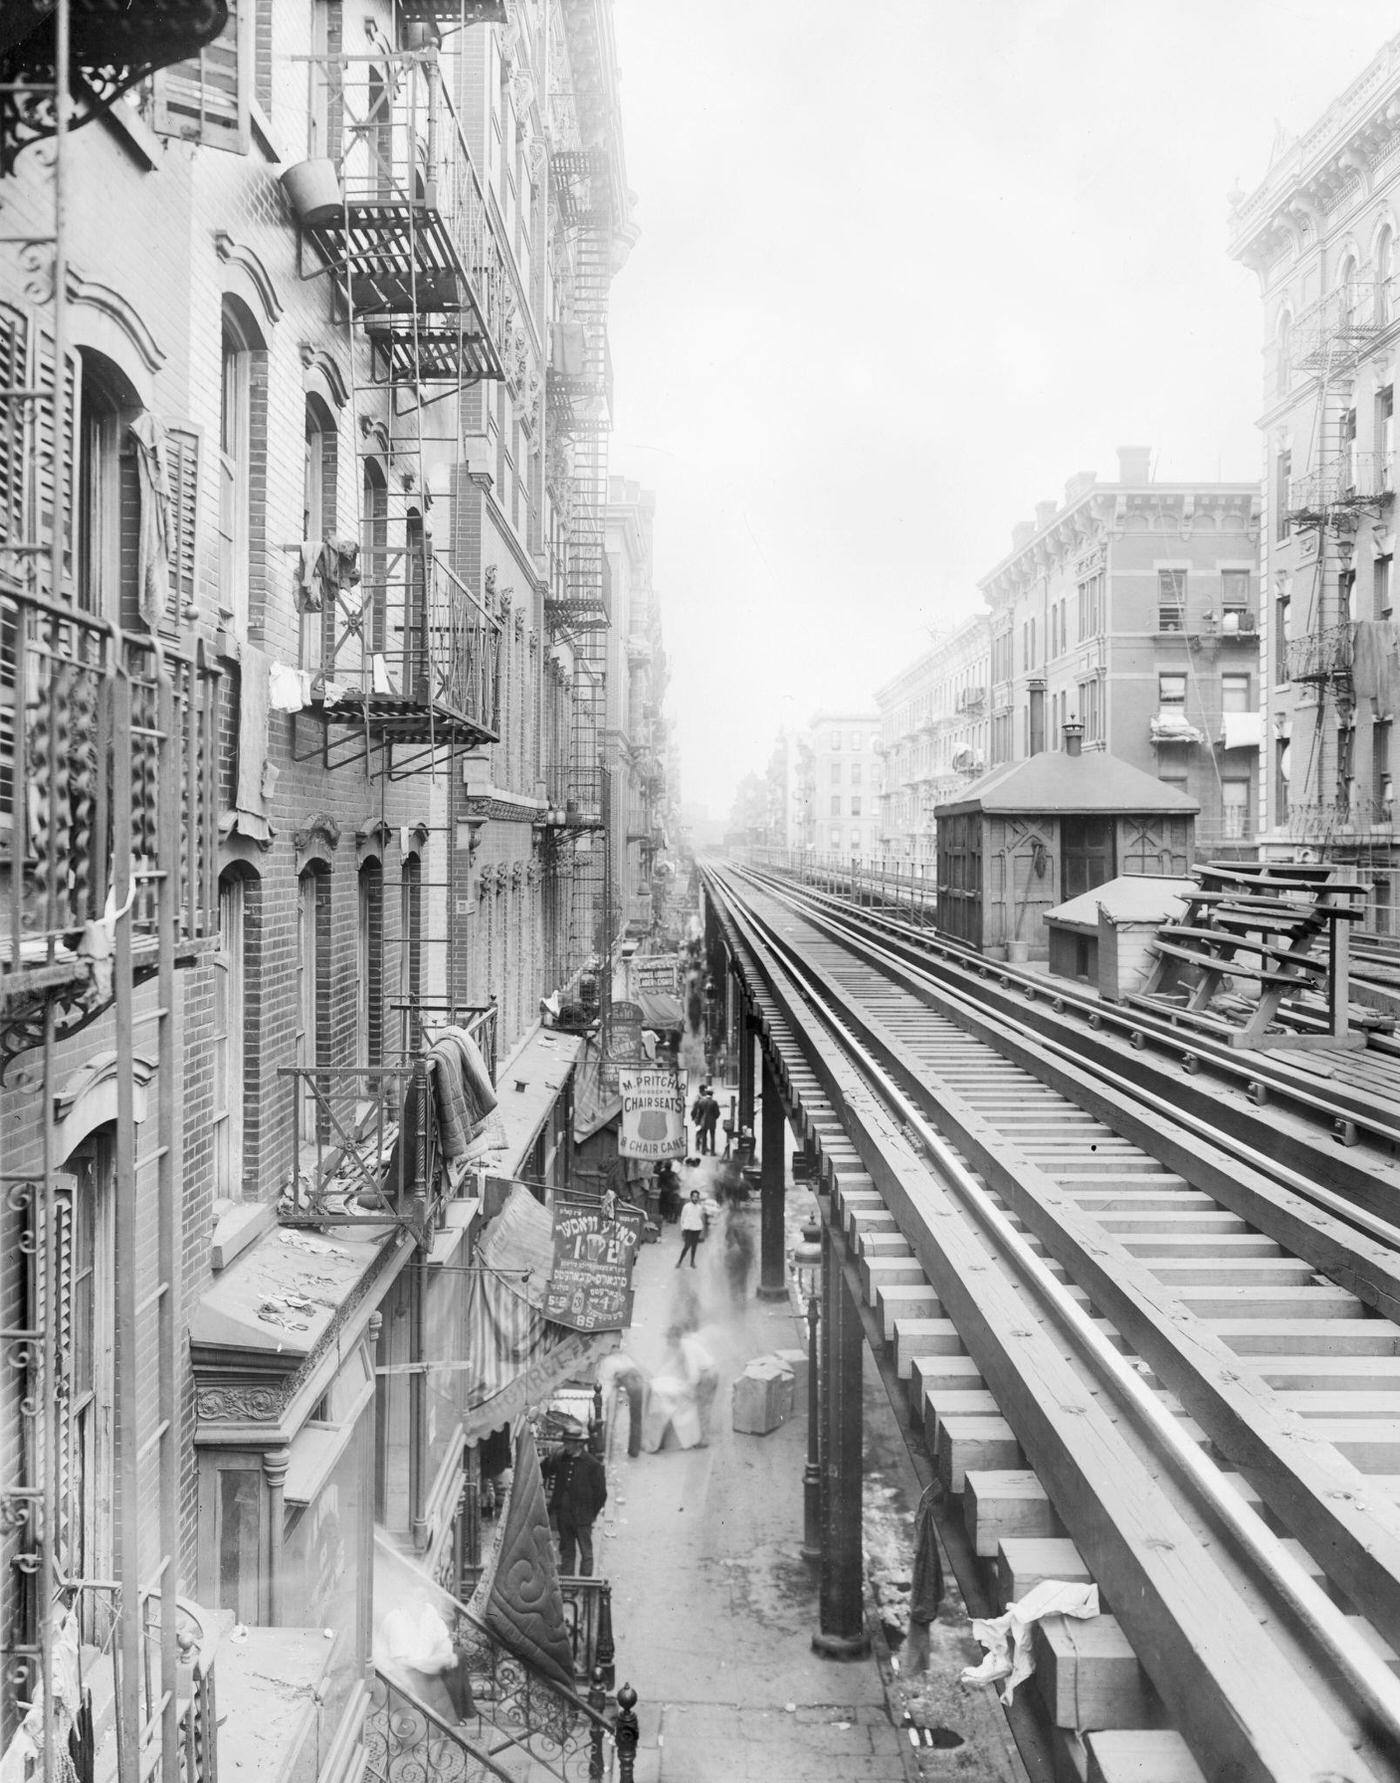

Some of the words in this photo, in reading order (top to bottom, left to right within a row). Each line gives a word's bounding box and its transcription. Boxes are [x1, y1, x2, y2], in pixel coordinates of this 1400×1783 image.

[624, 1097, 653, 1113] CHAIR
[654, 1097, 682, 1114] SEATS
[629, 1140, 659, 1153] CHAIR
